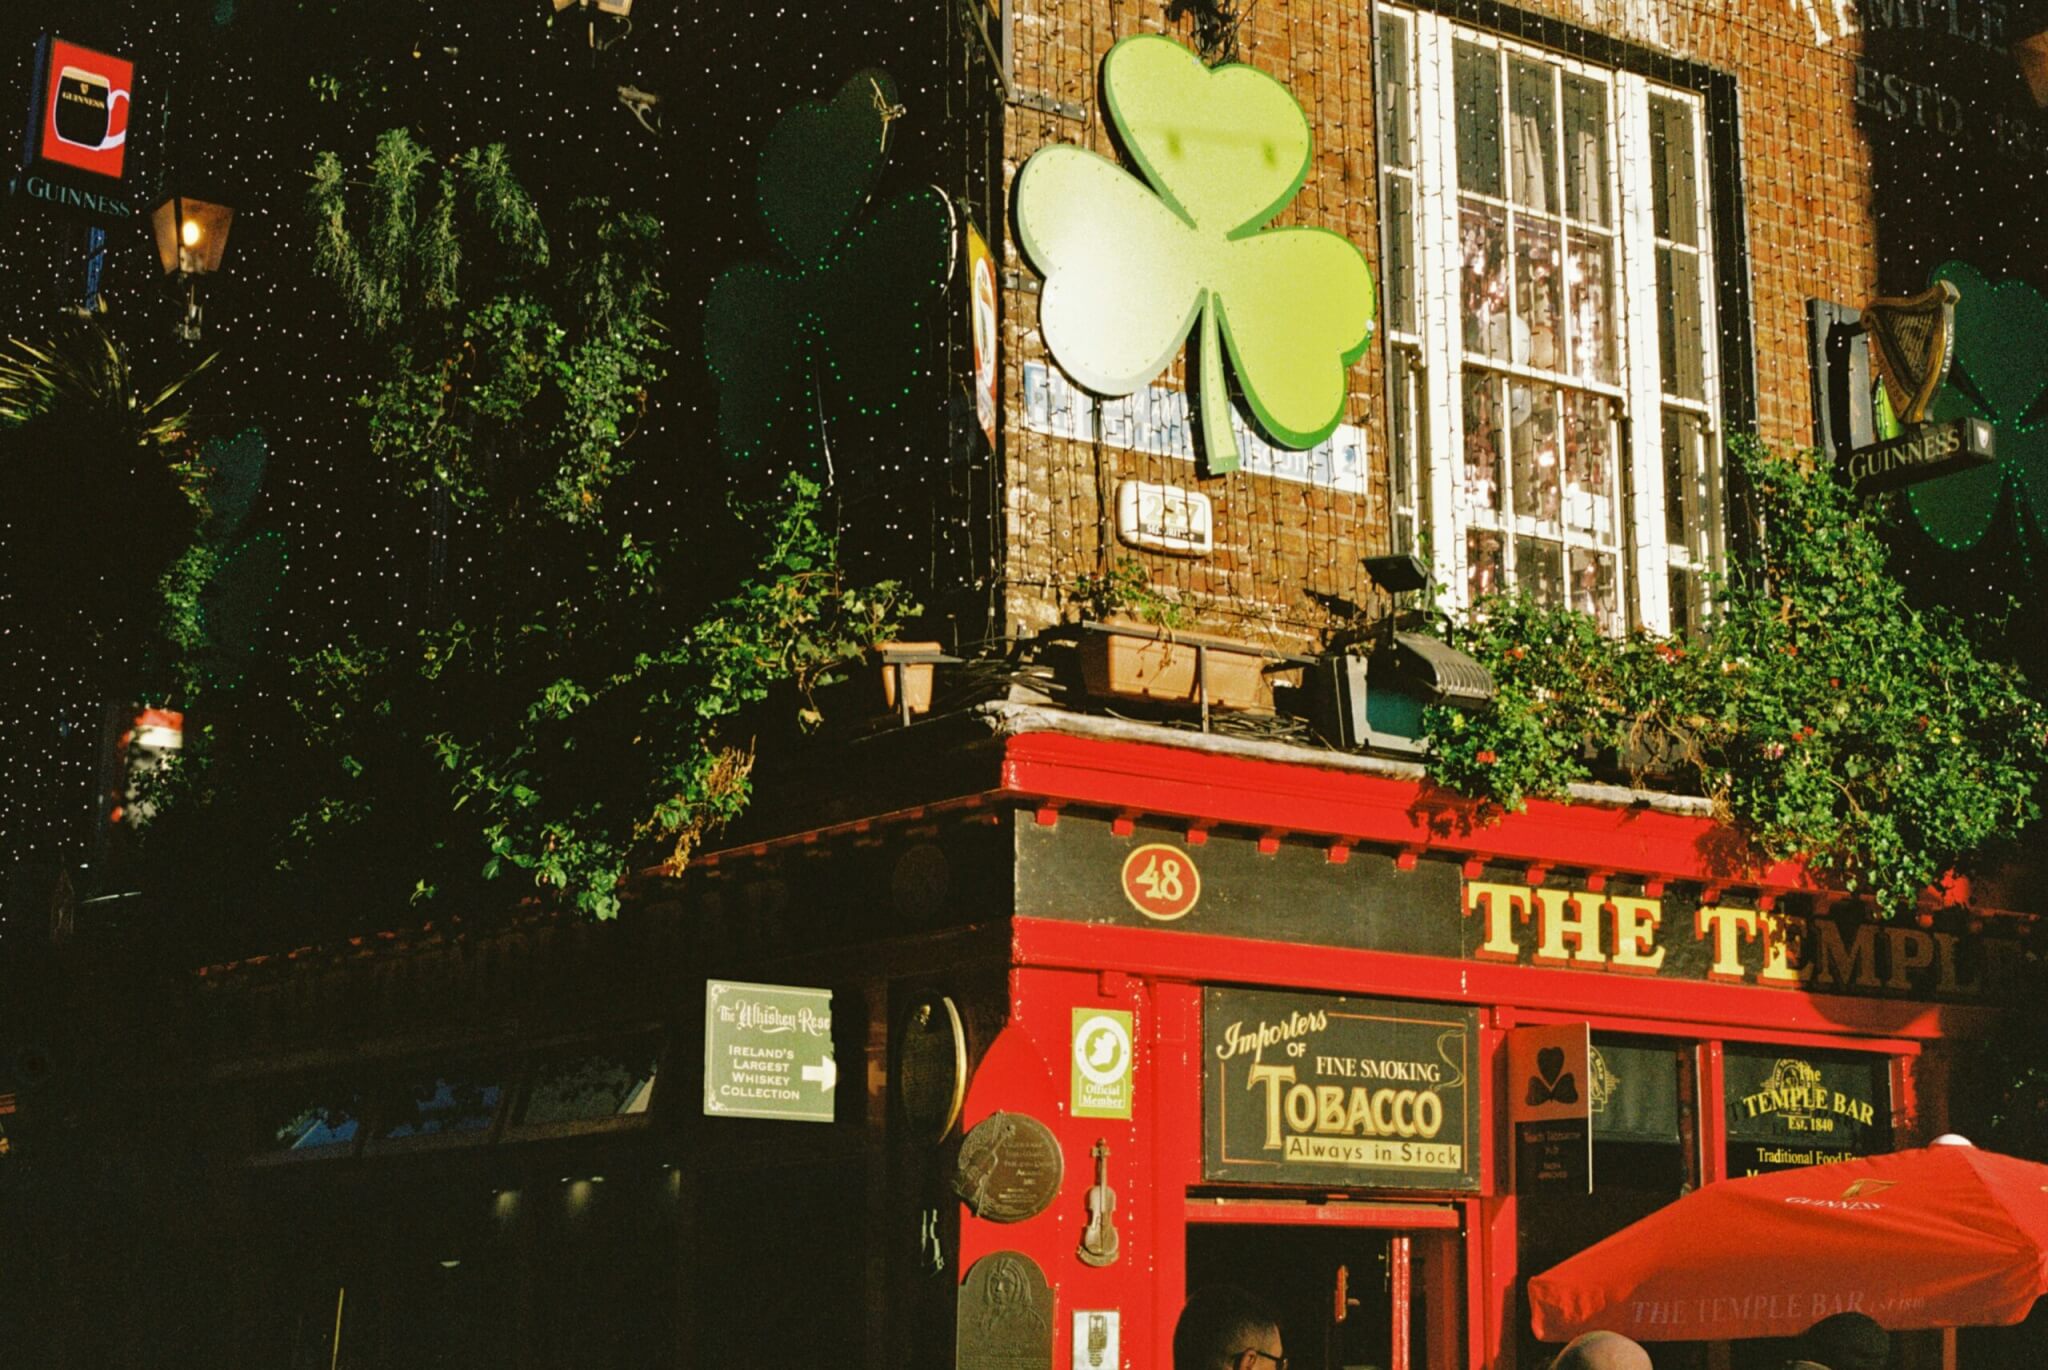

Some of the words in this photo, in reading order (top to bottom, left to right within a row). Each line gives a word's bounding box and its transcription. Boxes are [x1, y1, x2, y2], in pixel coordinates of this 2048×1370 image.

[62, 91, 105, 109] GUINNESS
[27, 176, 130, 217] GUINNESS
[1848, 428, 1960, 480] GUINNESS
[1135, 854, 1183, 901] 48
[1465, 882, 1666, 972] THE
[717, 1005, 735, 1022] The
[736, 999, 797, 1033] Whiskey
[1216, 1009, 1327, 1063] Importers
[729, 1044, 794, 1060] IRELAND'S
[1286, 1042, 1306, 1057] OF
[733, 1058, 790, 1073] LARGEST
[1316, 1056, 1357, 1077] FINE
[1360, 1060, 1441, 1082] SMOKING
[1797, 1061, 1822, 1082] The
[732, 1071, 791, 1087] WHISKEY
[1085, 1083, 1120, 1096] Official
[720, 1084, 800, 1101] COLLECTION
[1083, 1095, 1123, 1107] Member
[1247, 1064, 1442, 1149] TOBACCO
[1743, 1087, 1828, 1118] TEMPLE
[1833, 1091, 1875, 1127] BAR
[1788, 1117, 1808, 1131] Est.
[1810, 1118, 1834, 1132] 1840
[1289, 1137, 1363, 1161] Always
[1374, 1143, 1392, 1161] in
[1401, 1142, 1458, 1165] Stock
[1756, 1147, 1813, 1165] Traditional
[1815, 1150, 1842, 1165] Food
[1785, 1195, 1884, 1210] GUINNESS
[1632, 1299, 1687, 1324] THE
[1696, 1295, 1802, 1323] TEMPLE
[1811, 1290, 1865, 1317] BAR
